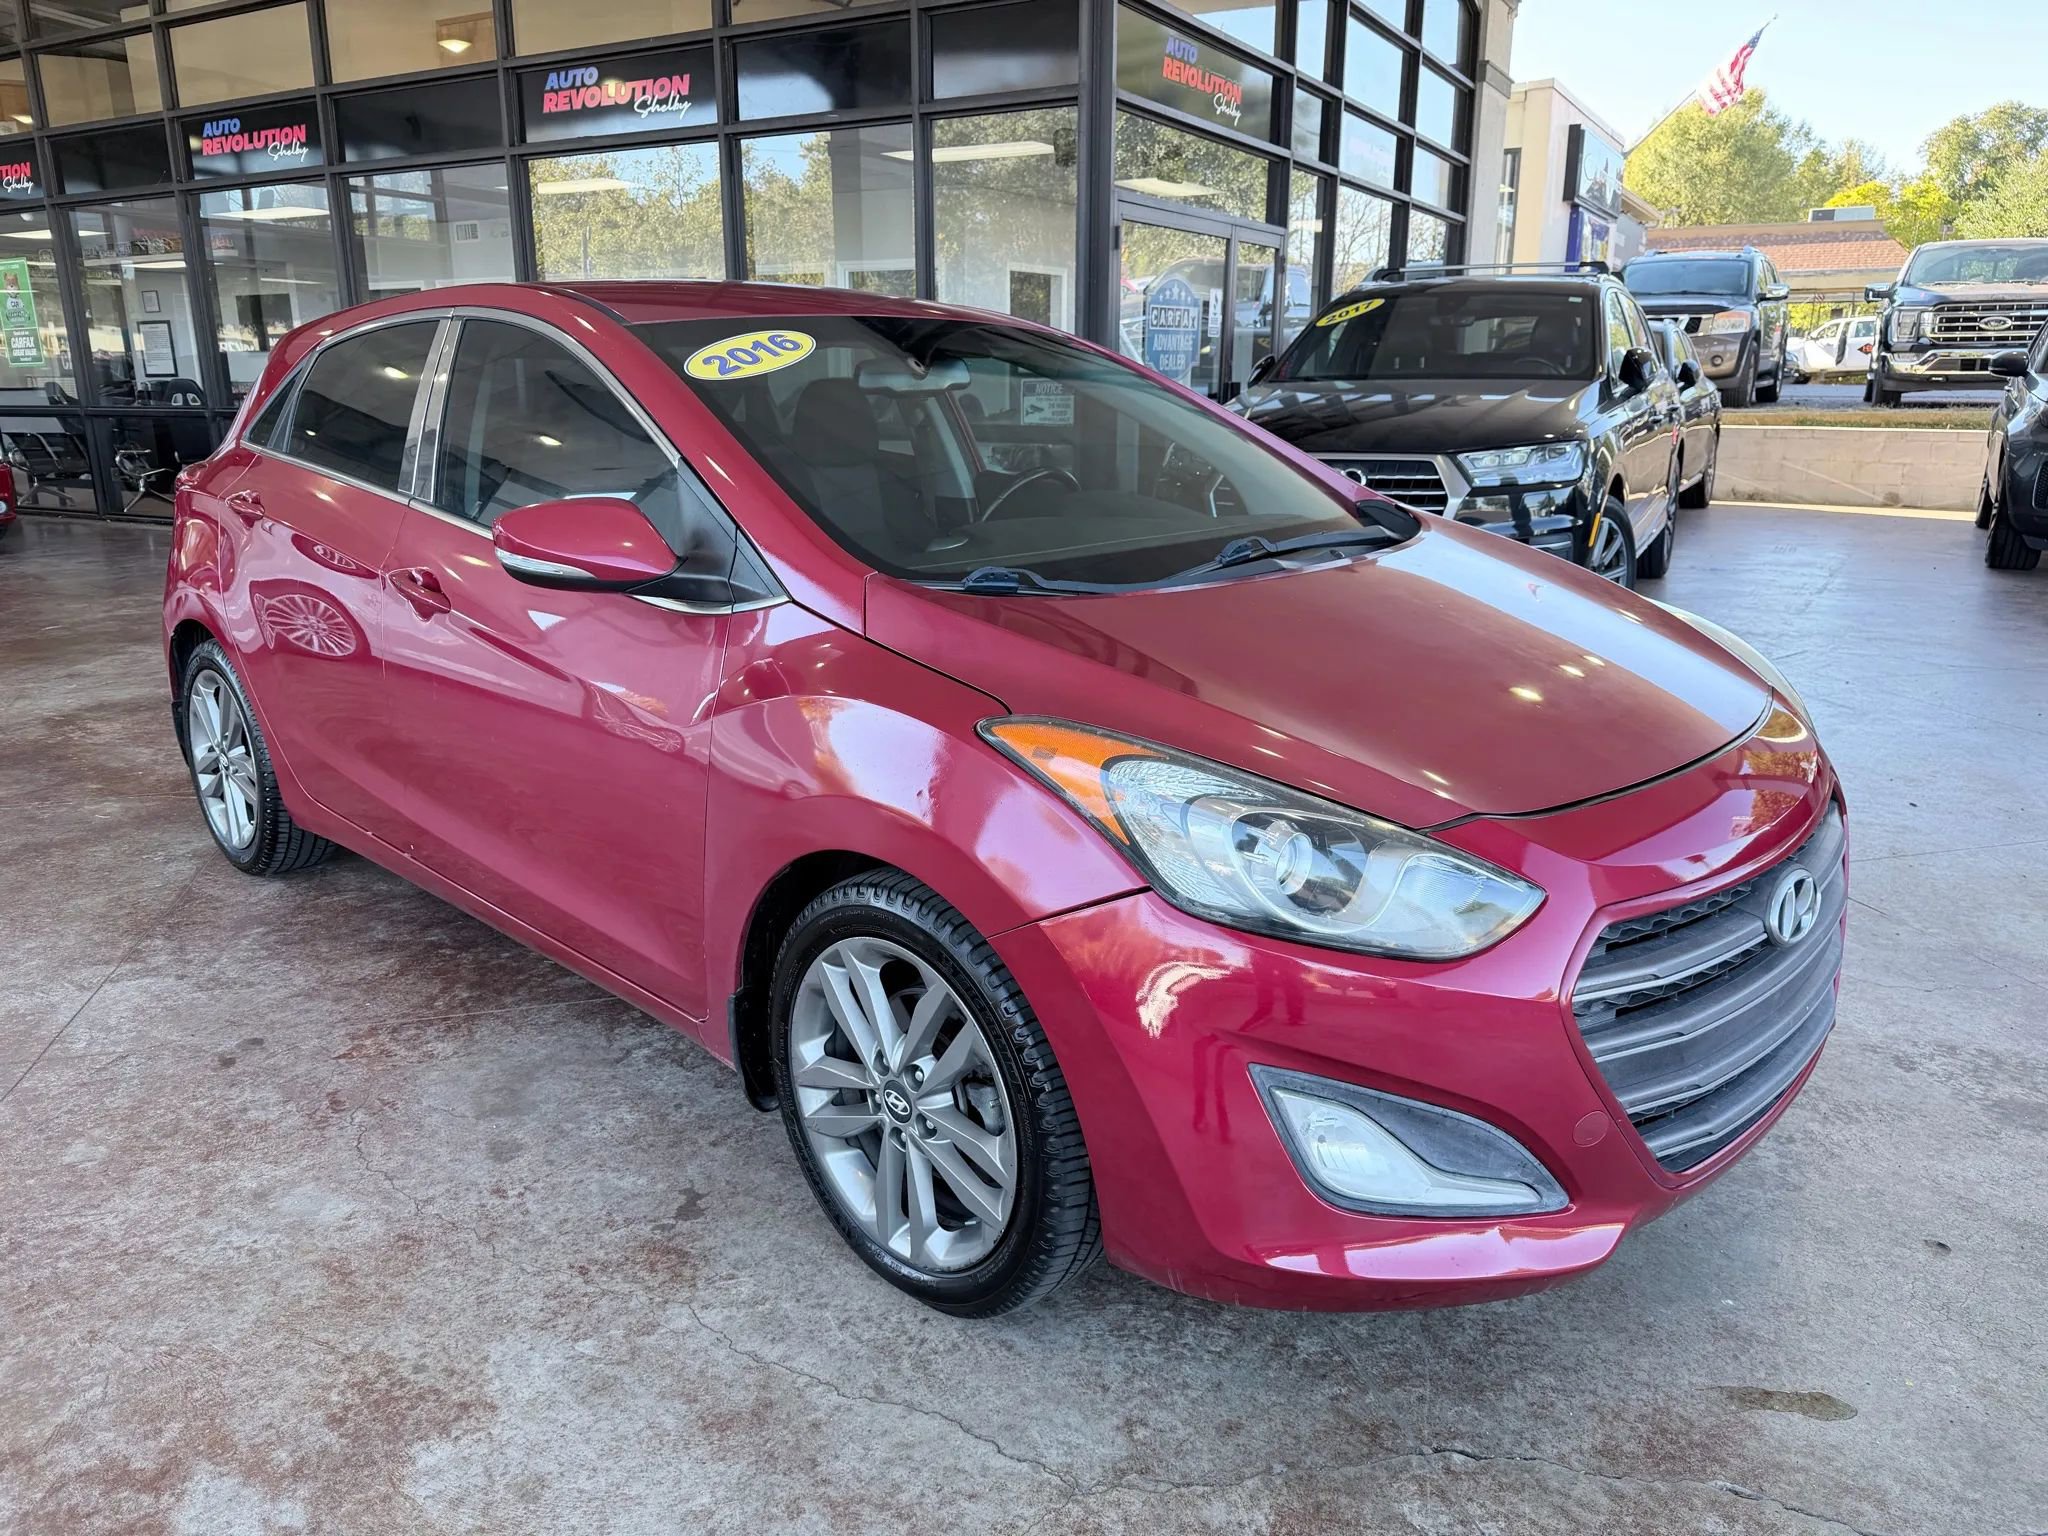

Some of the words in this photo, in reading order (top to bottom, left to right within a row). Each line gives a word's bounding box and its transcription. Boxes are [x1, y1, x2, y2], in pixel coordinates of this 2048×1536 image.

[1165, 36, 1197, 64] AUTO
[545, 66, 599, 90] AUTO
[1163, 56, 1242, 105] REVOLUTION
[543, 74, 690, 113] REVOLUTION
[634, 91, 691, 120] Shelby
[1214, 93, 1241, 126] Shelby
[202, 124, 306, 156] REVOLUTION
[203, 118, 241, 138] AUTO
[268, 138, 309, 162] Shelby
[3, 173, 33, 194] Shelby
[1151, 307, 1197, 329] CARFAX
[1325, 301, 1374, 324] 2017
[11, 336, 35, 348] CARFAX
[1153, 334, 1193, 351] ADVANTAGE
[702, 334, 803, 376] 2016
[1160, 354, 1186, 370] DEALER
[1036, 383, 1065, 394] NOTICE
